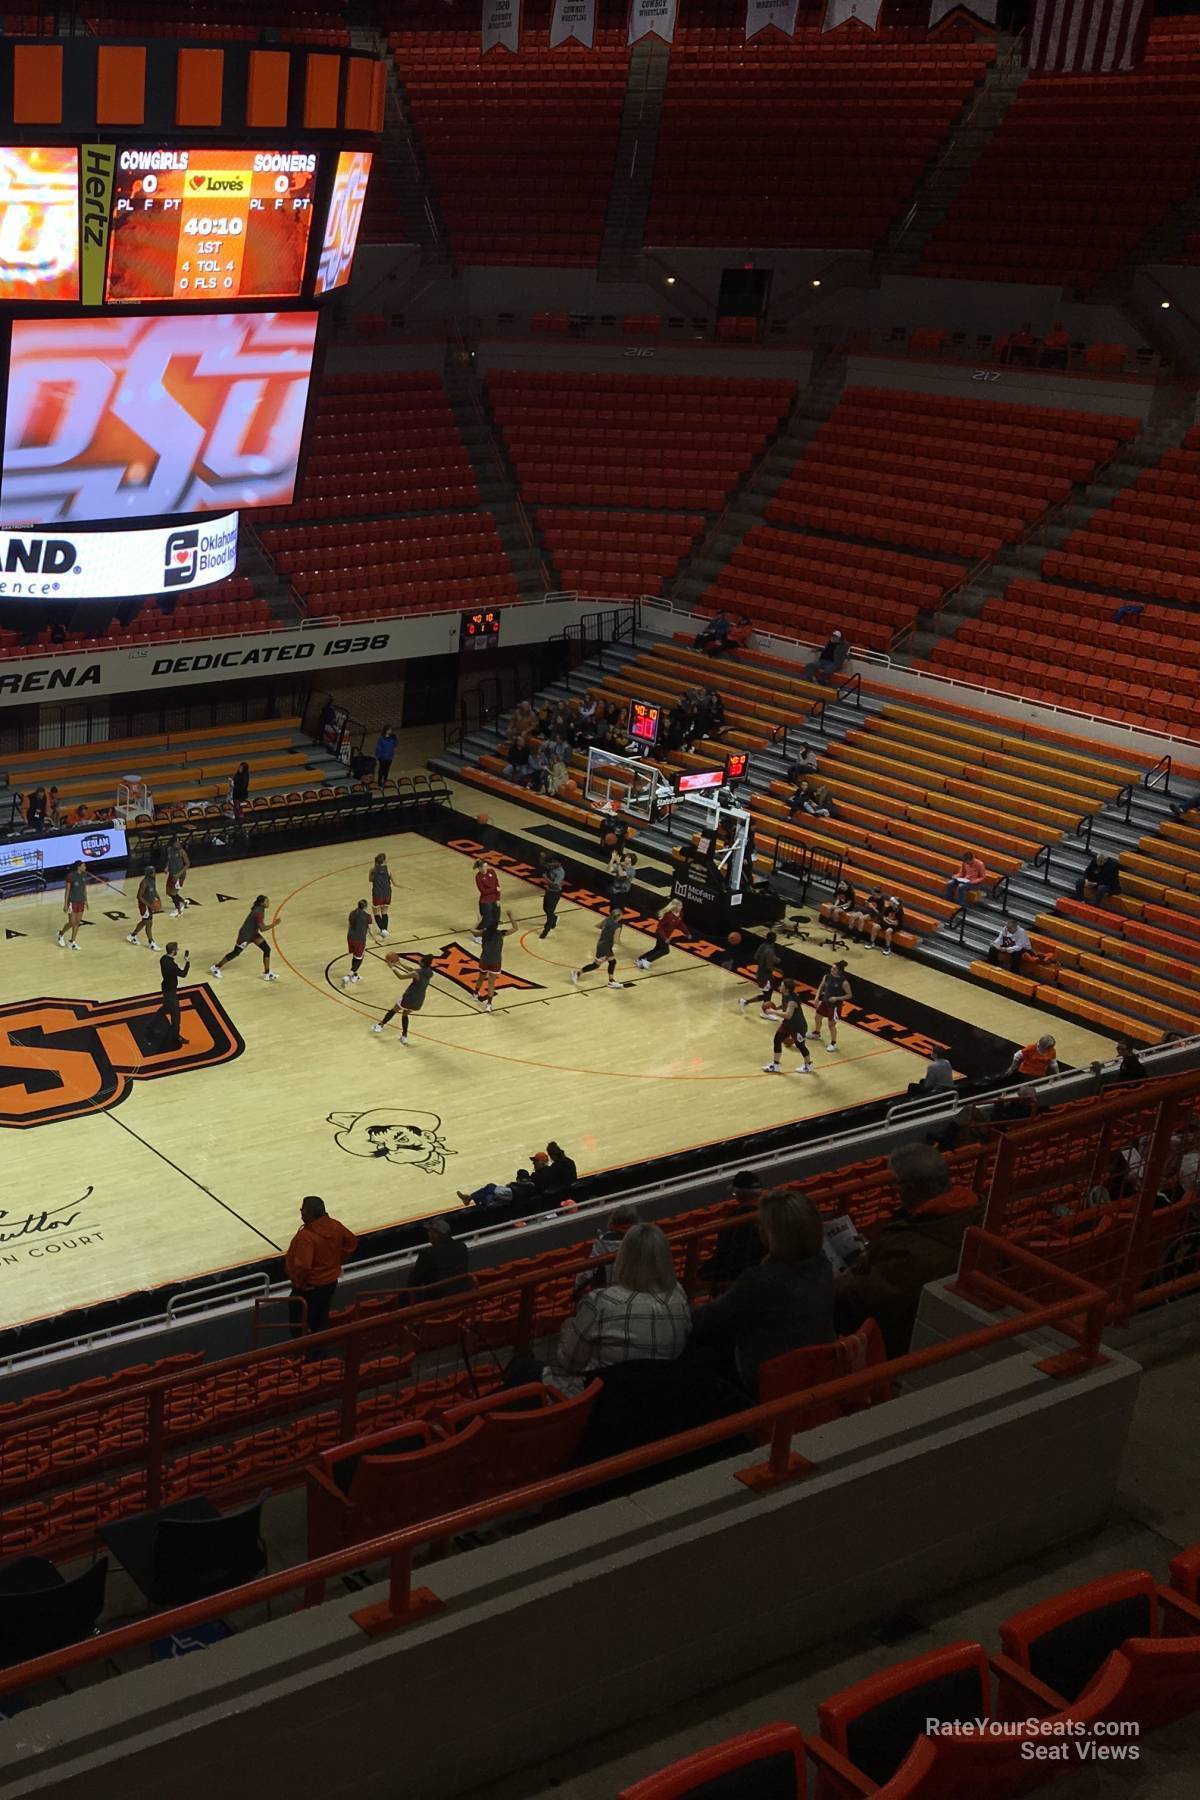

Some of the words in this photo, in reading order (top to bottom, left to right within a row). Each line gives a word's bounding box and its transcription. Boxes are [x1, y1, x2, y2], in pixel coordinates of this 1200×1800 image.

[563, 5, 585, 13] COWBOY
[641, 0, 667, 8] COWBOY
[639, 8, 668, 17] WRESTLING
[120, 150, 189, 171] COWGIRLS
[253, 153, 317, 173] SOONERS
[142, 174, 158, 193] 0
[206, 176, 244, 192] Love's
[274, 175, 289, 193] 0
[84, 150, 111, 248] Hertz
[117, 199, 134, 211] PL
[144, 199, 154, 211] F
[163, 199, 182, 210] PT
[250, 199, 265, 211] PL
[274, 198, 284, 210] F
[292, 198, 311, 210] PT
[184, 217, 243, 236] 40:10
[197, 241, 223, 255] 1ST
[181, 260, 191, 272] 4
[198, 260, 221, 272] TOL
[225, 260, 234, 272] 4
[179, 277, 189, 289] 0
[194, 277, 217, 289] FLS
[224, 277, 233, 289] 0
[624, 346, 657, 358] 216
[972, 370, 1001, 381] 217
[0, 312, 309, 522] OSU
[200, 547, 227, 571] Blood
[151, 641, 315, 676] DEDICATED
[323, 634, 390, 657] 1938
[82, 837, 110, 850] BEDLAM
[28, 1232, 105, 1258] COURT
